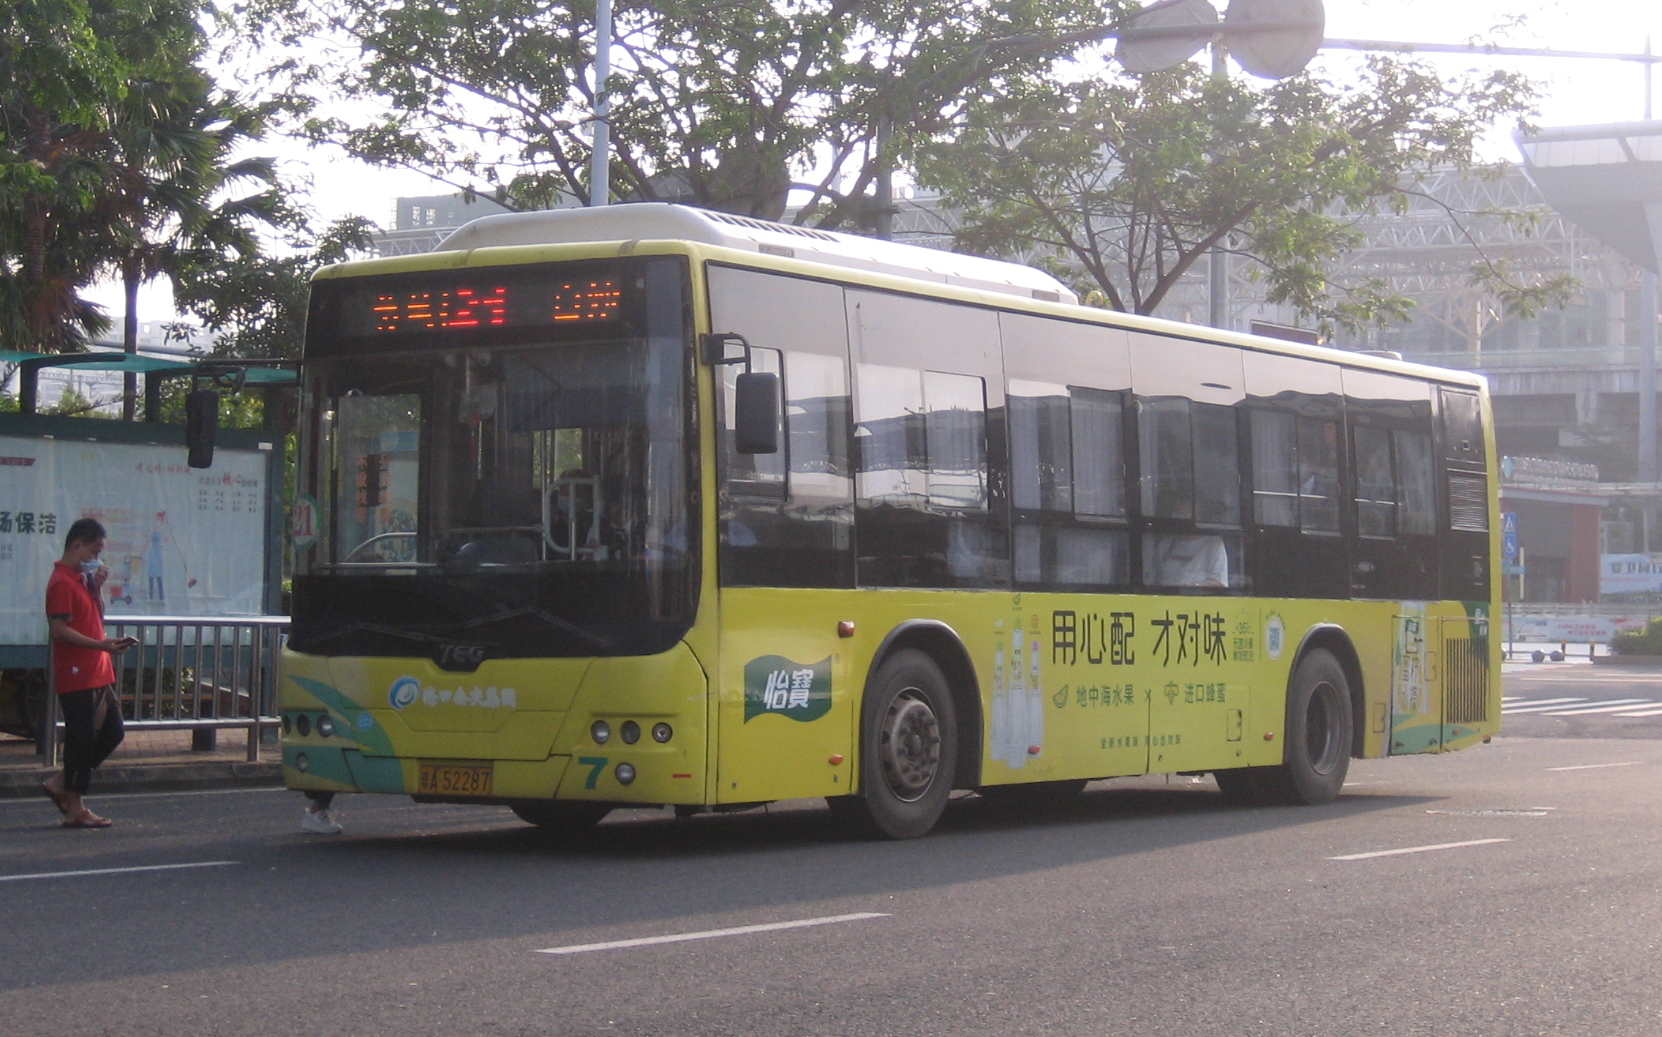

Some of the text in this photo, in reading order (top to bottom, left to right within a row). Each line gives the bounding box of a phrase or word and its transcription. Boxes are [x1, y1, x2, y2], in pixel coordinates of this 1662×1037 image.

[293, 505, 313, 536] 21
[1053, 610, 1227, 668] 用心配 才对味
[1076, 682, 1226, 708] 地中海水果 进口蜂蜜
[578, 756, 609, 790] 7
